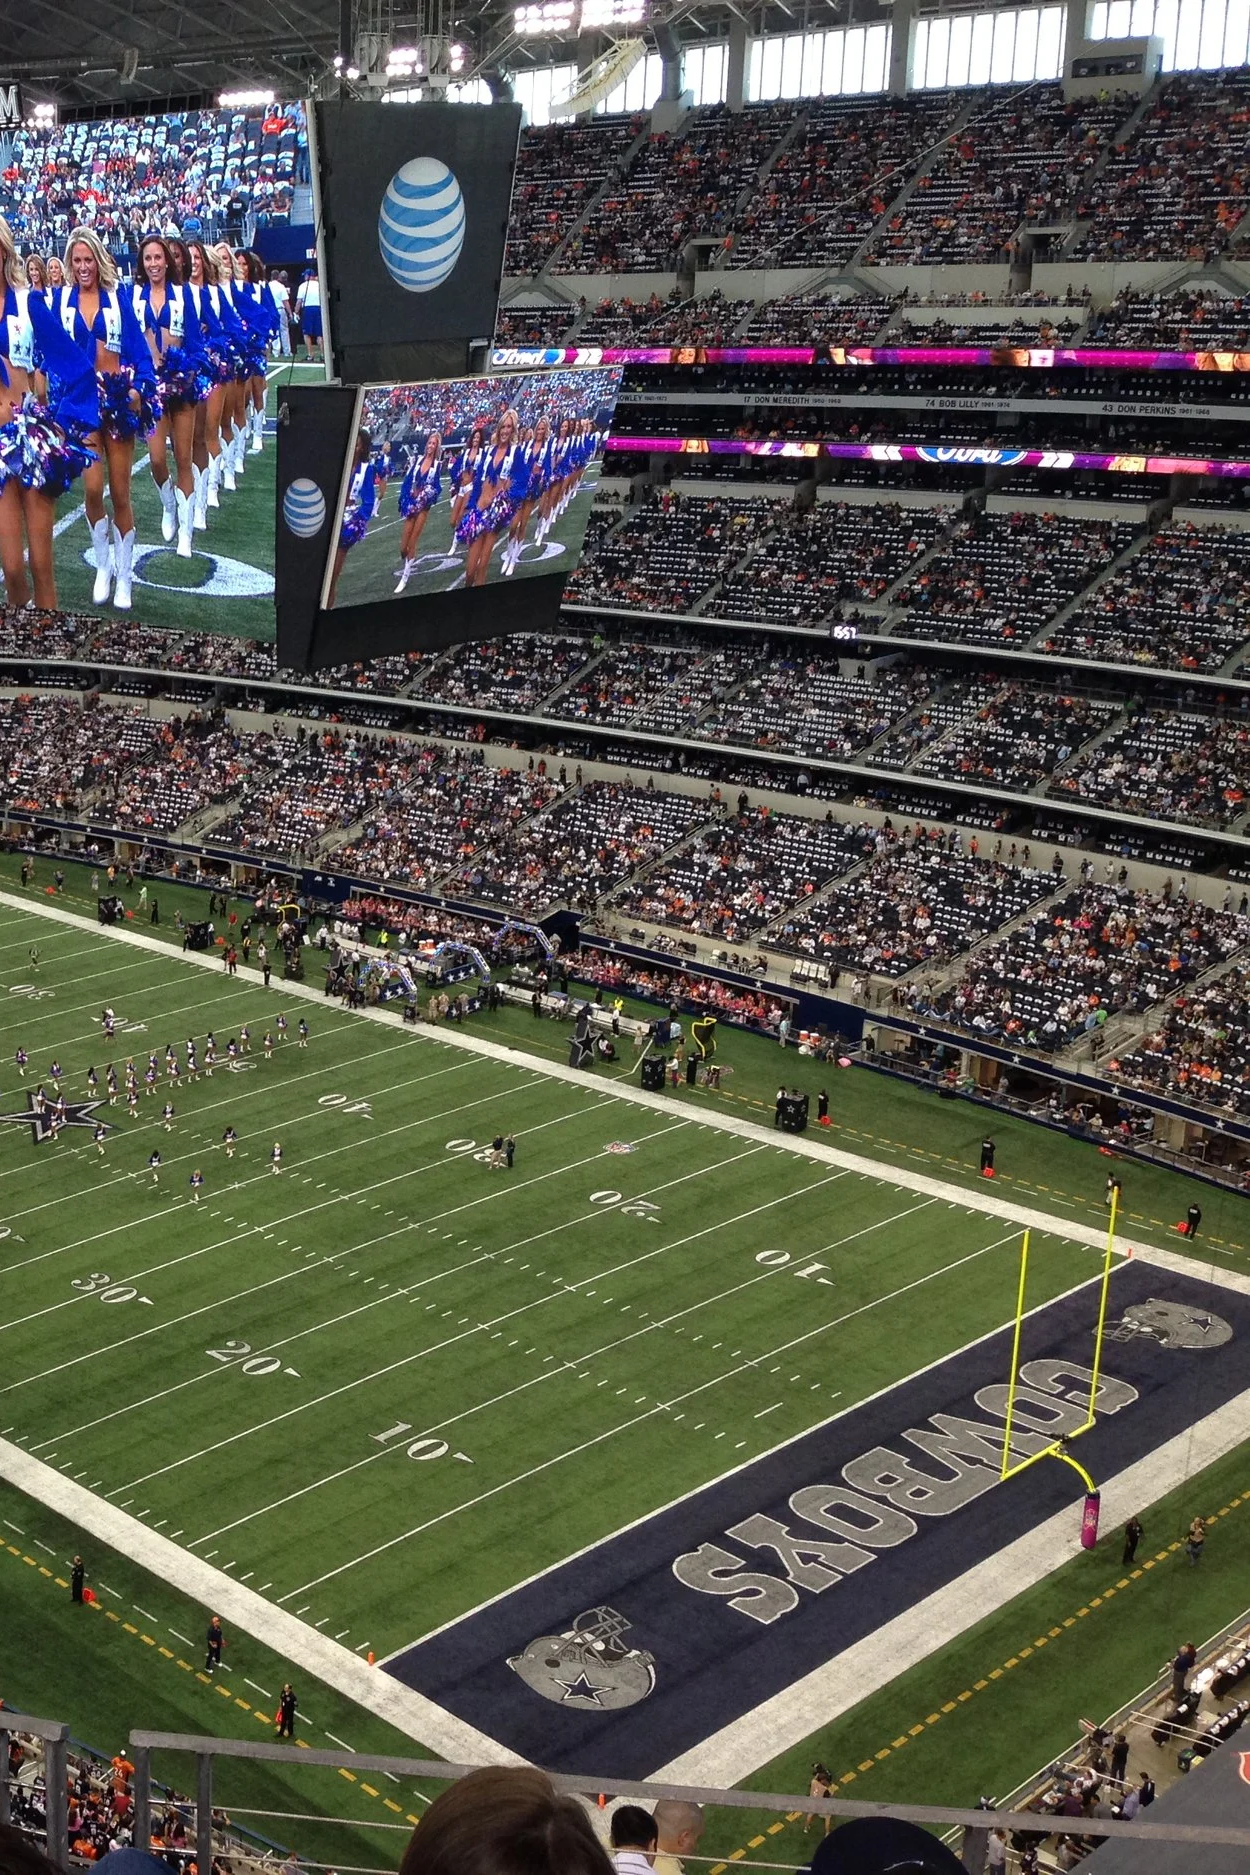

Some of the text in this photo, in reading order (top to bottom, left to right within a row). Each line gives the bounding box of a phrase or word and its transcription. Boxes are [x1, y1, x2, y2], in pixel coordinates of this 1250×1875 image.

[744, 396, 752, 404] 17
[754, 396, 770, 404] DON
[772, 396, 810, 405] MEREDITH
[925, 399, 936, 408] 74
[939, 399, 956, 408] BOB
[958, 400, 980, 408] LILLY
[1102, 404, 1113, 413] 43
[1117, 404, 1137, 413] DON
[1139, 405, 1177, 415] PERKINS
[318, 1093, 373, 1113] 40
[589, 1190, 662, 1217] 20
[755, 1249, 832, 1279] 10
[70, 1272, 138, 1304] 30
[205, 1340, 282, 1375] 20
[368, 1420, 449, 1460] 10
[672, 1358, 1139, 1624] COWBOYS
